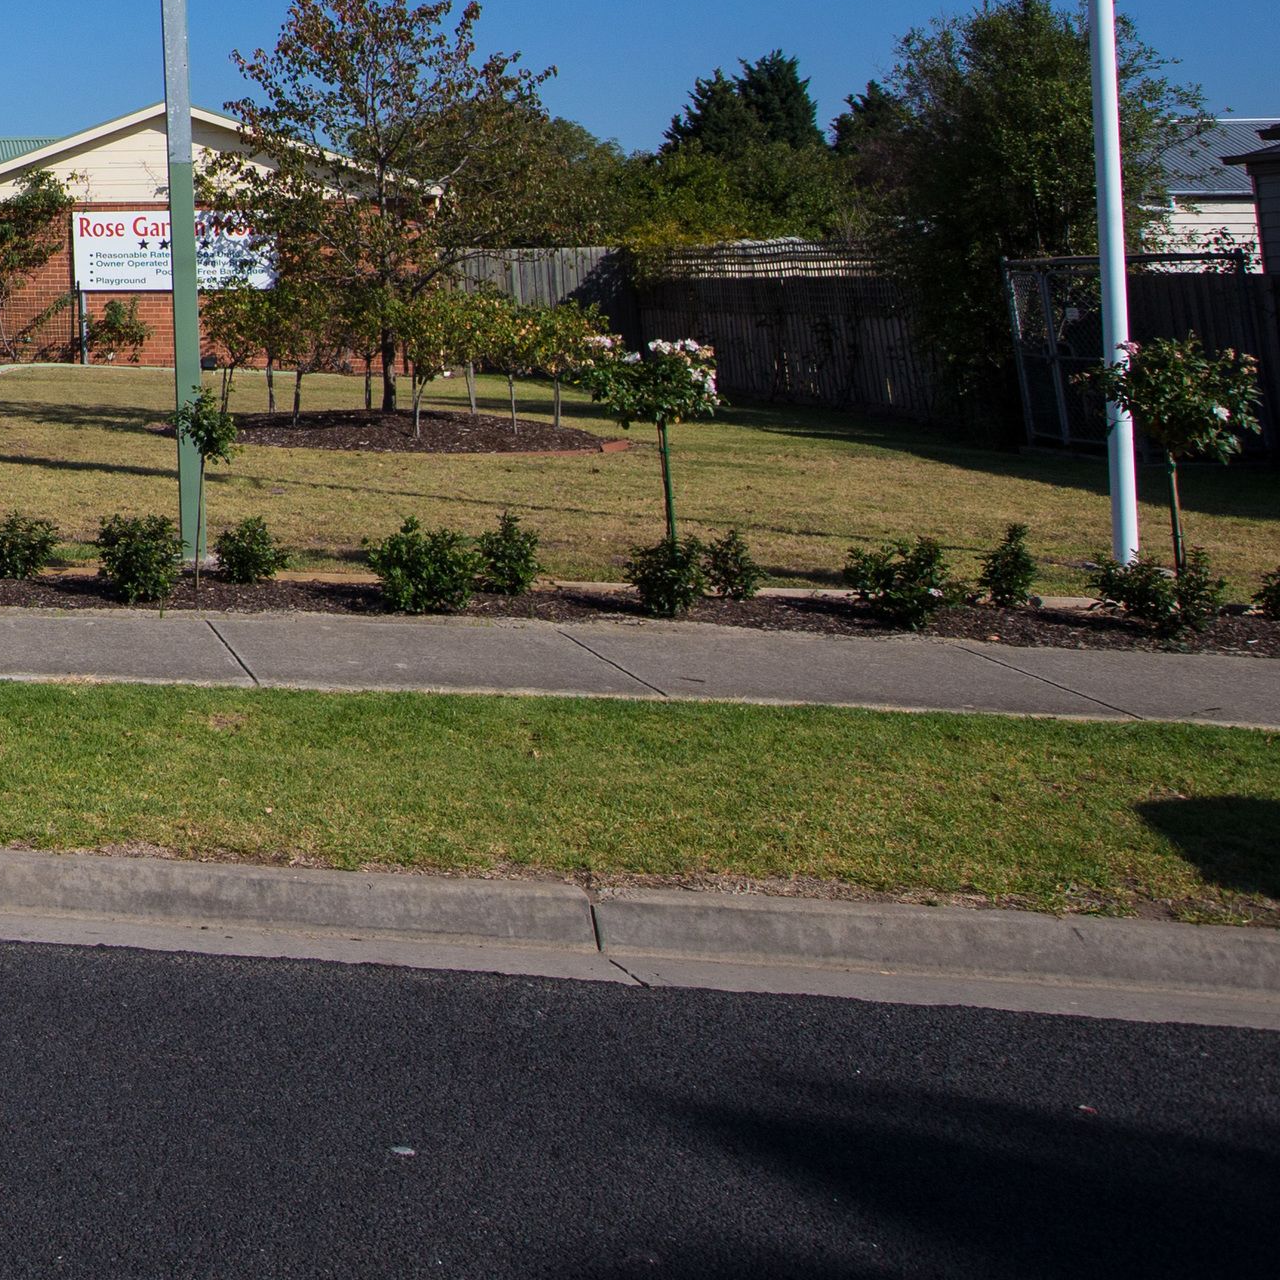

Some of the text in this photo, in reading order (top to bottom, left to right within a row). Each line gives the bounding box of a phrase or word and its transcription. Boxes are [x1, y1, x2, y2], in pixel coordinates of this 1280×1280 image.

[79, 217, 125, 238] Rose
[95, 251, 148, 259] Reasonable
[95, 260, 169, 269] Owner Operated
[95, 277, 148, 286] Playground
